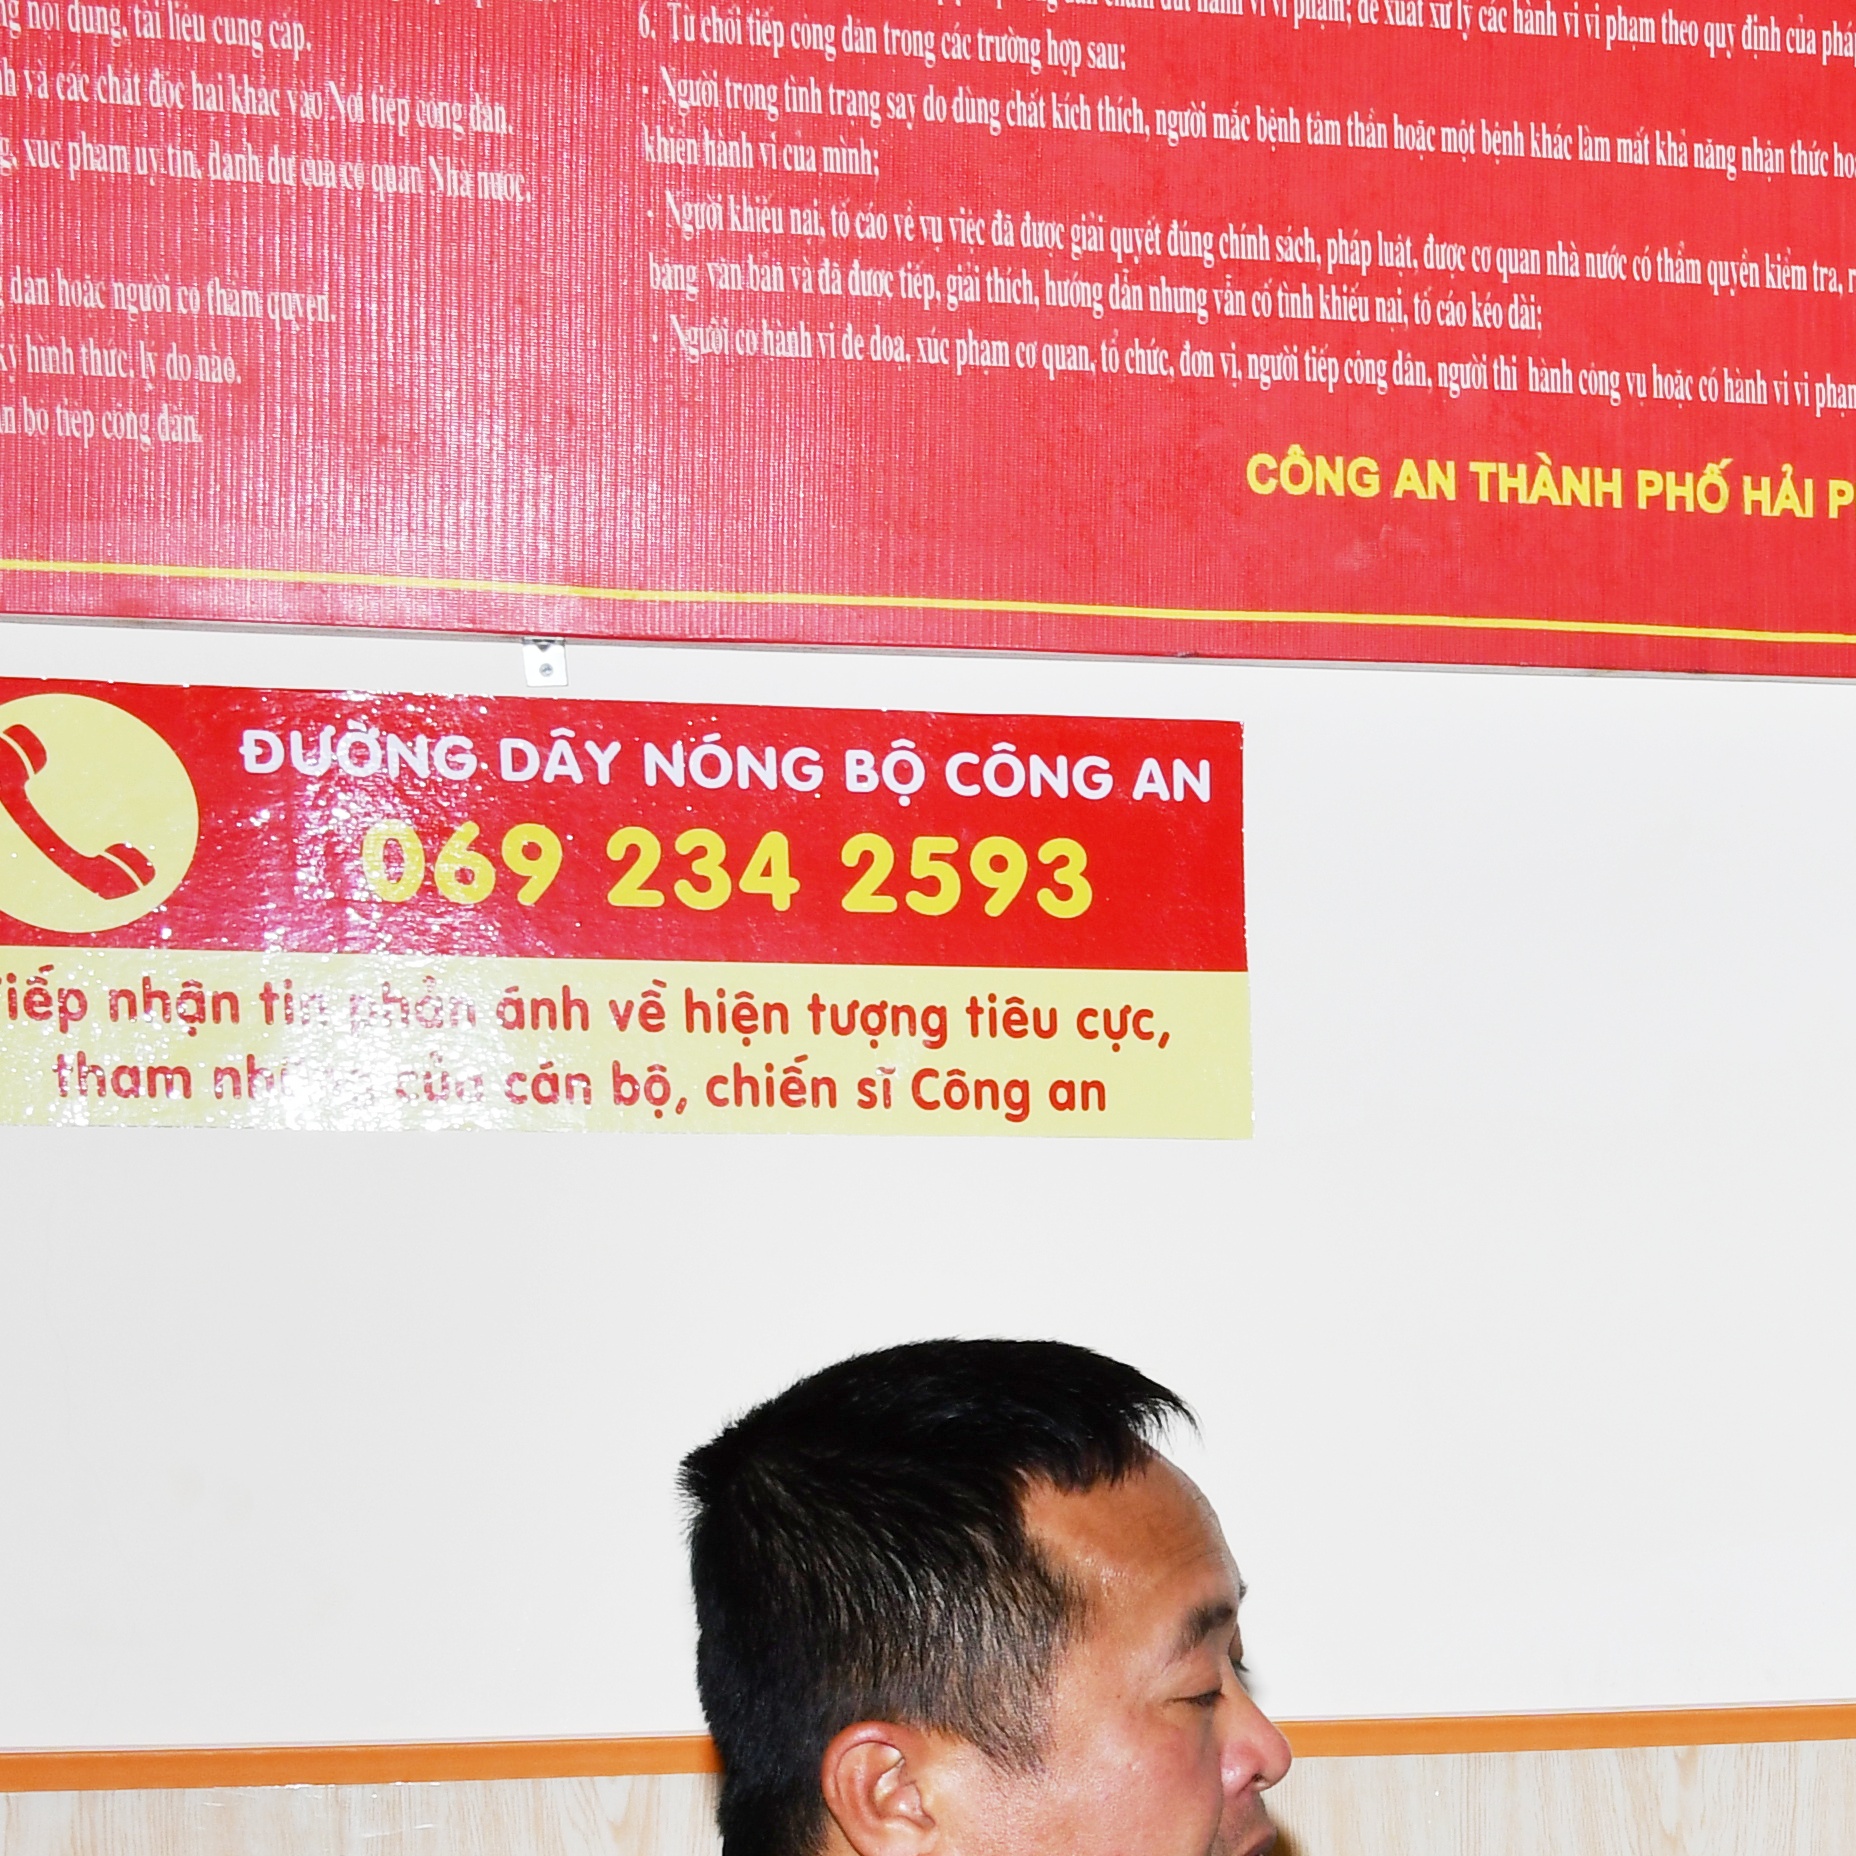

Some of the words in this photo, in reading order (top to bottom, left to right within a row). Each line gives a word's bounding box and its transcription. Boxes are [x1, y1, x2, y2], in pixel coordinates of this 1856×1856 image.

[884, 22, 935, 65] trong
[977, 26, 1041, 72] trường
[1149, 276, 1208, 324] nhưng
[1252, 279, 1272, 317] cố
[1278, 282, 1313, 318] tình
[1414, 292, 1431, 324] tố
[1437, 291, 1466, 327] cáo
[1472, 292, 1503, 328] kéo
[1247, 444, 1380, 497] CÔNG
[1394, 459, 1456, 500] AN
[1469, 454, 1622, 508] THÀNH
[1638, 457, 1732, 513] PHỐ
[1743, 467, 1813, 517] HẢI
[241, 719, 477, 781] ĐƯỜNG
[502, 728, 621, 784] DÂY
[644, 733, 823, 791] NÓNG
[845, 738, 926, 807] BỘ
[945, 741, 1114, 800] CÔNG
[1132, 757, 1211, 803] AN
[362, 821, 562, 904] 069
[607, 827, 800, 911] 234
[842, 833, 1092, 918] 2593
[0, 964, 88, 1033] iếp
[108, 976, 240, 1036] nhận
[498, 985, 590, 1031] ánh
[609, 979, 668, 1033] về
[684, 986, 789, 1047] hiện
[807, 992, 947, 1050] tượng
[966, 995, 1058, 1039] tiêu
[1076, 1005, 1171, 1052] cực,
[53, 1051, 193, 1099] tham
[503, 1060, 592, 1107] cán
[612, 1059, 687, 1120] bộ,
[705, 1054, 838, 1109] chiến
[857, 1066, 894, 1110] sĩ
[911, 1067, 1030, 1122] Công
[1048, 1075, 1107, 1112] an
